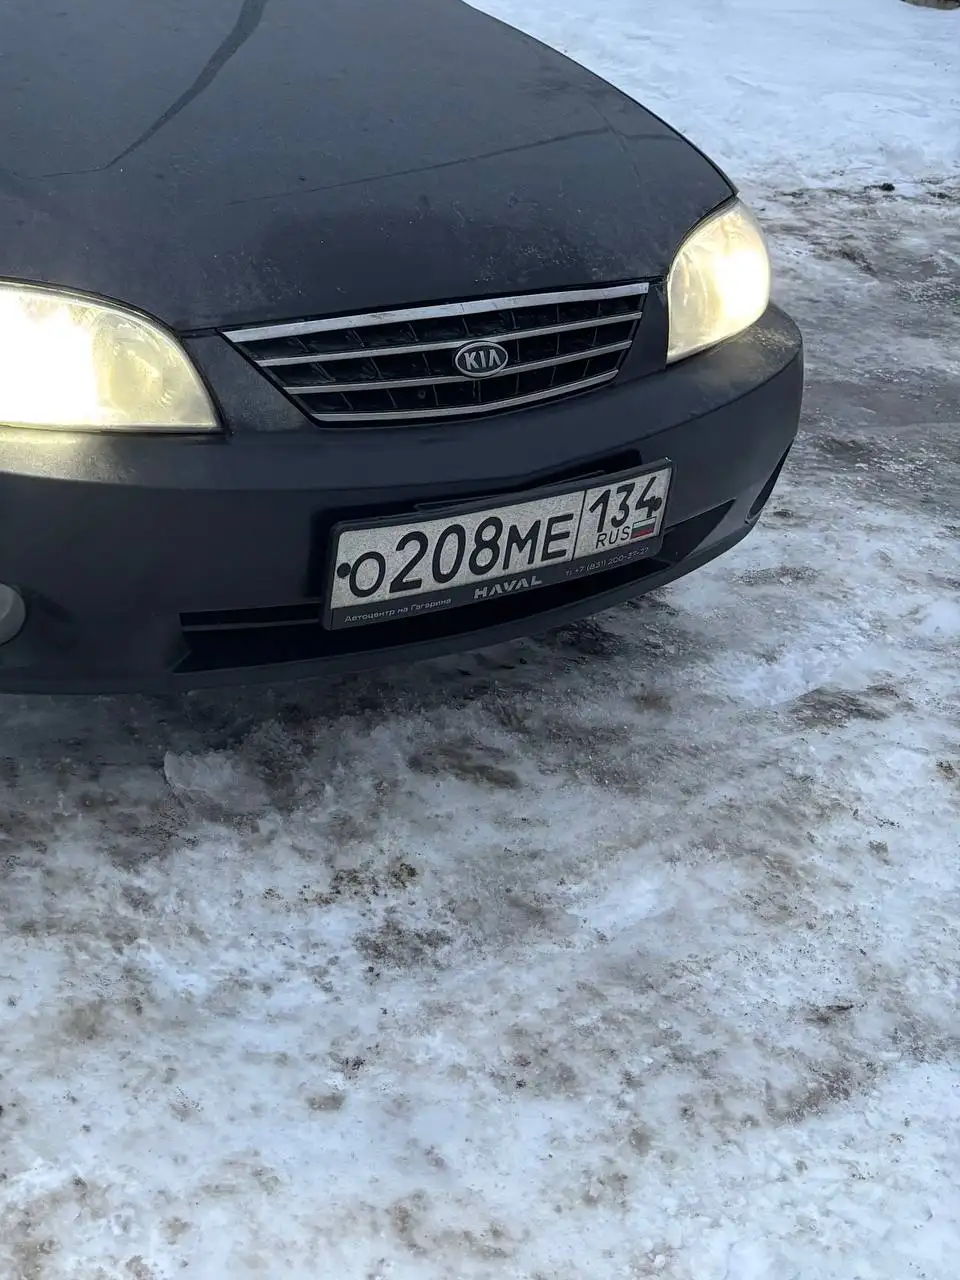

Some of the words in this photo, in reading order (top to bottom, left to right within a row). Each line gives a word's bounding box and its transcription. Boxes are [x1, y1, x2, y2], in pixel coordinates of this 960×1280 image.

[464, 349, 501, 370] KIA
[349, 513, 574, 598] О208МЕ
[589, 476, 658, 533] 134
[596, 526, 631, 549] RUS
[473, 575, 542, 599] HAVAL
